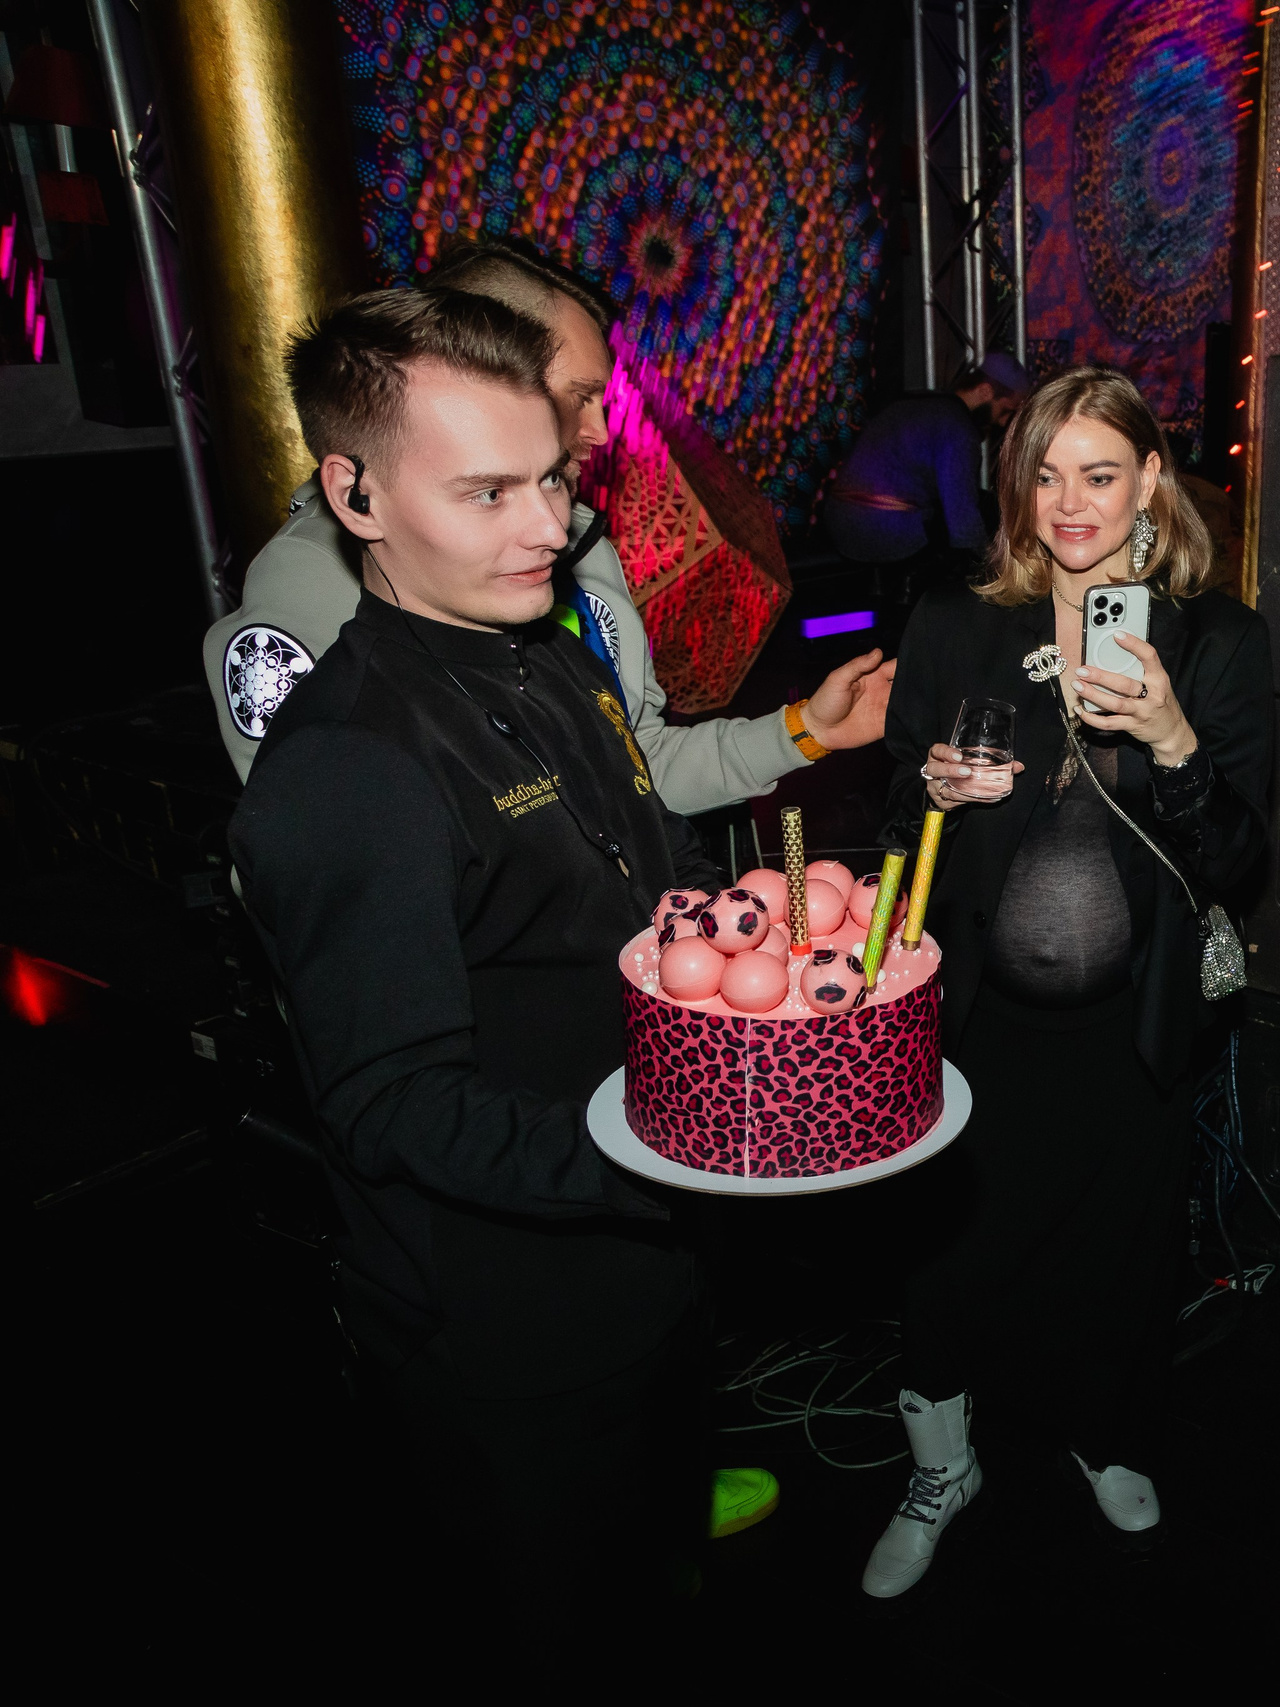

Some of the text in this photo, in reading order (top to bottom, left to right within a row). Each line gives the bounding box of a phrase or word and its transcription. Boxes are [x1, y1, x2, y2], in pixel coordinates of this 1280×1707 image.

[492, 775, 561, 811] buddha-bar
[510, 791, 559, 818] SAINT PETERSBUR
